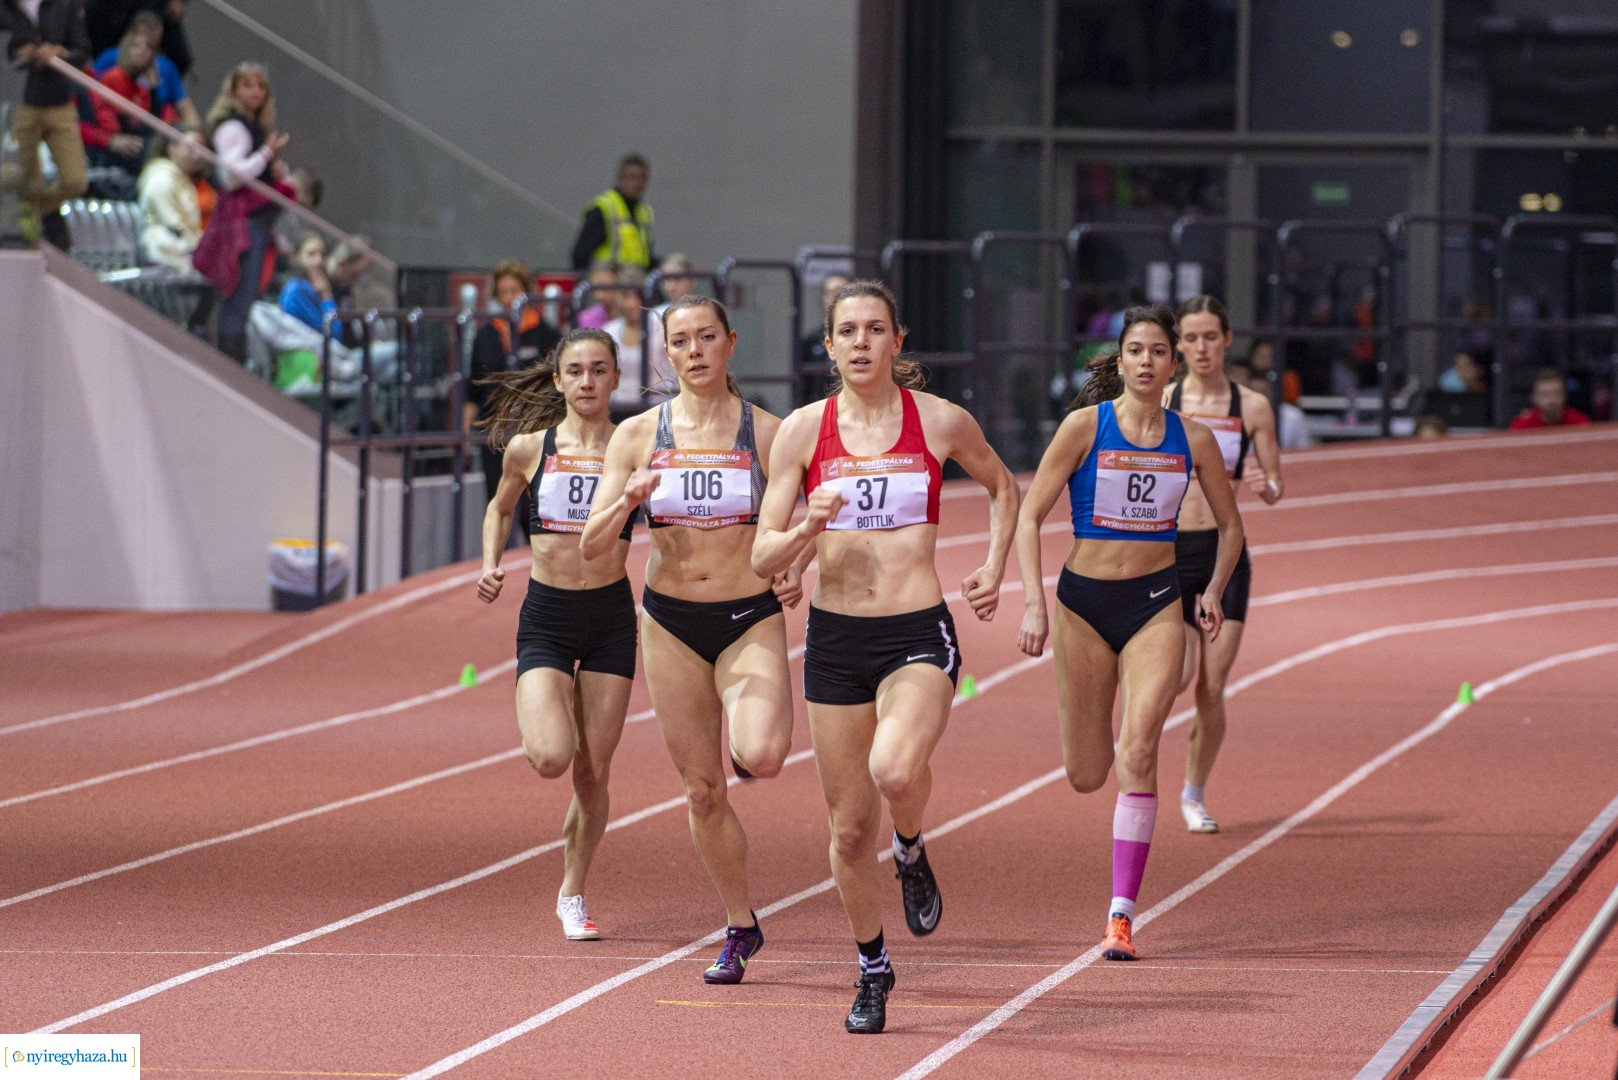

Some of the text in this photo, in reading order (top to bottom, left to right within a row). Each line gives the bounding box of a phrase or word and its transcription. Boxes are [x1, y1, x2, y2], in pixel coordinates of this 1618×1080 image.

[687, 453, 741, 461] FEDETTPÁLYÁS
[856, 458, 913, 468] FEDETTPÁLYÁS
[568, 475, 599, 505] 87
[680, 470, 723, 501] 106
[1127, 473, 1157, 503] 62
[856, 477, 889, 511] 37
[687, 504, 713, 516] SZÉLL
[1121, 506, 1157, 519] K. SZABÓ
[663, 516, 719, 528] NYÍREGYHÁZA
[857, 514, 895, 529] BOTTLIK
